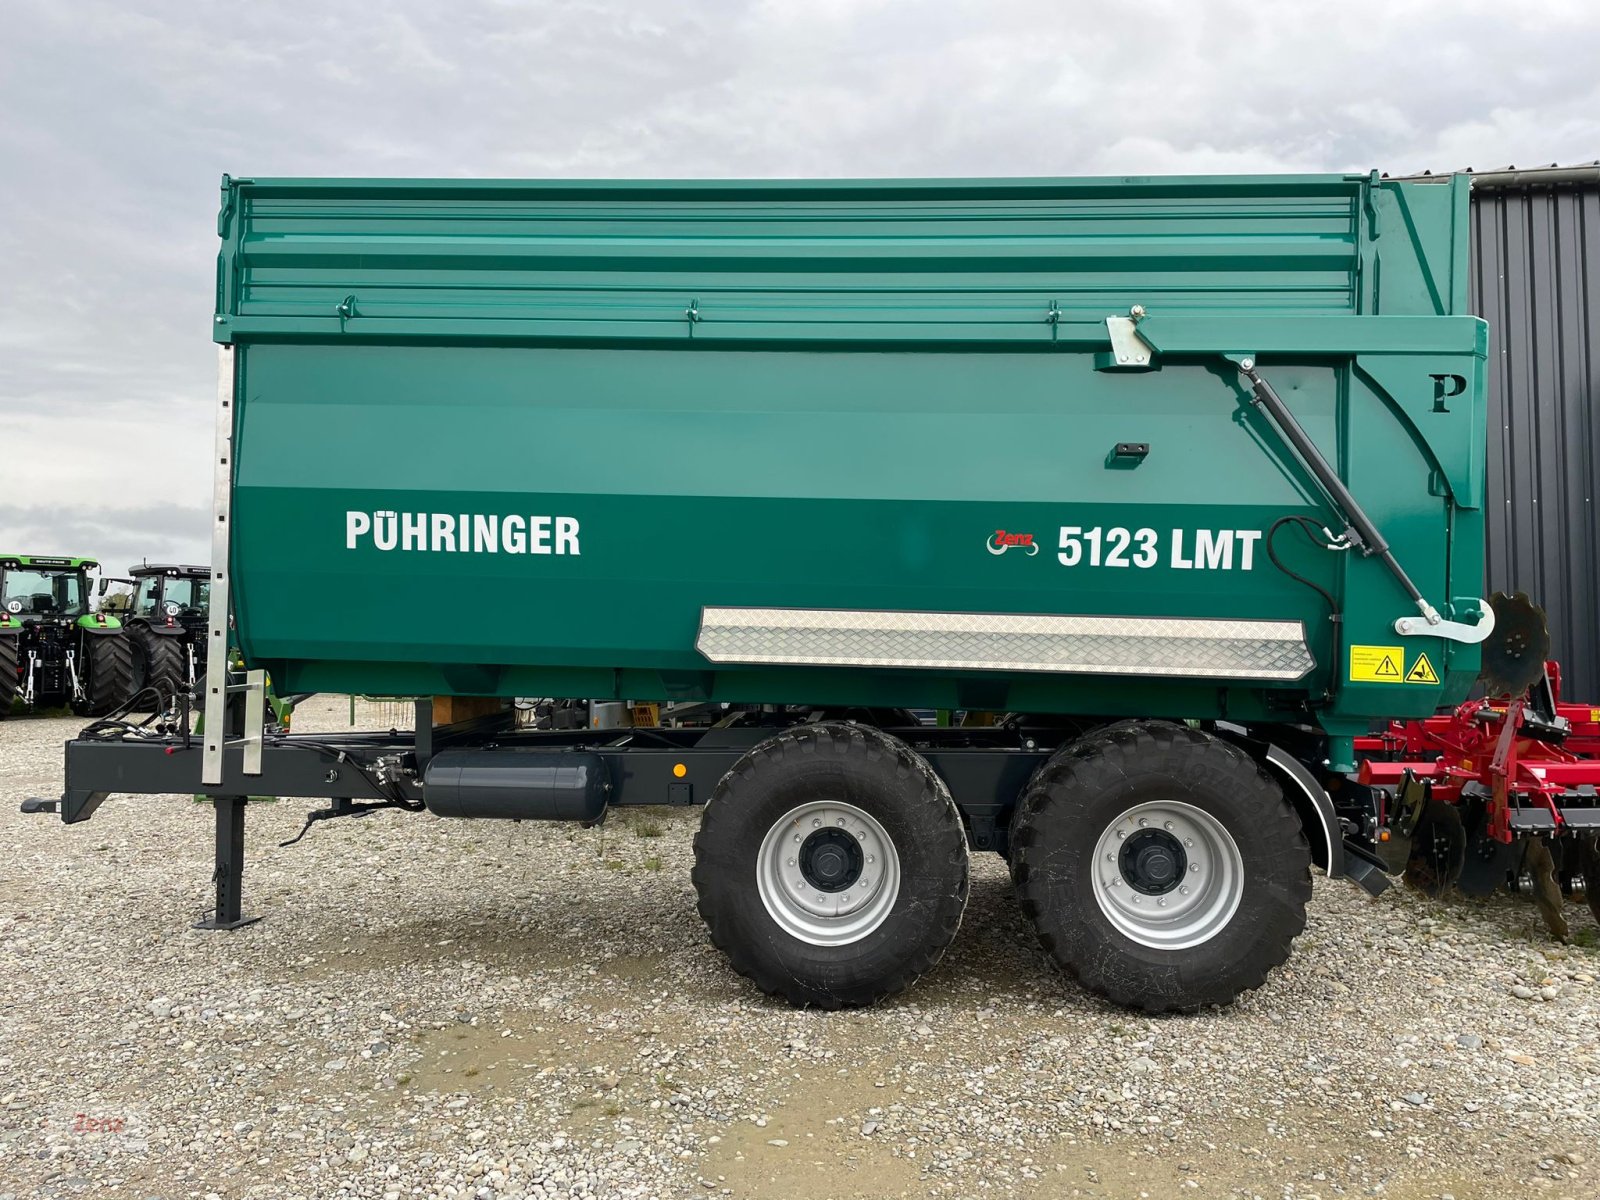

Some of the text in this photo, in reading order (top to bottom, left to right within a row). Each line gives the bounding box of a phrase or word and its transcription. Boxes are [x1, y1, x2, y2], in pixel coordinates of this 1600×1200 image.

[346, 510, 581, 555] PÜHRINGER
[995, 529, 1033, 546] Zenz
[1057, 526, 1262, 571] 5123 LMT
